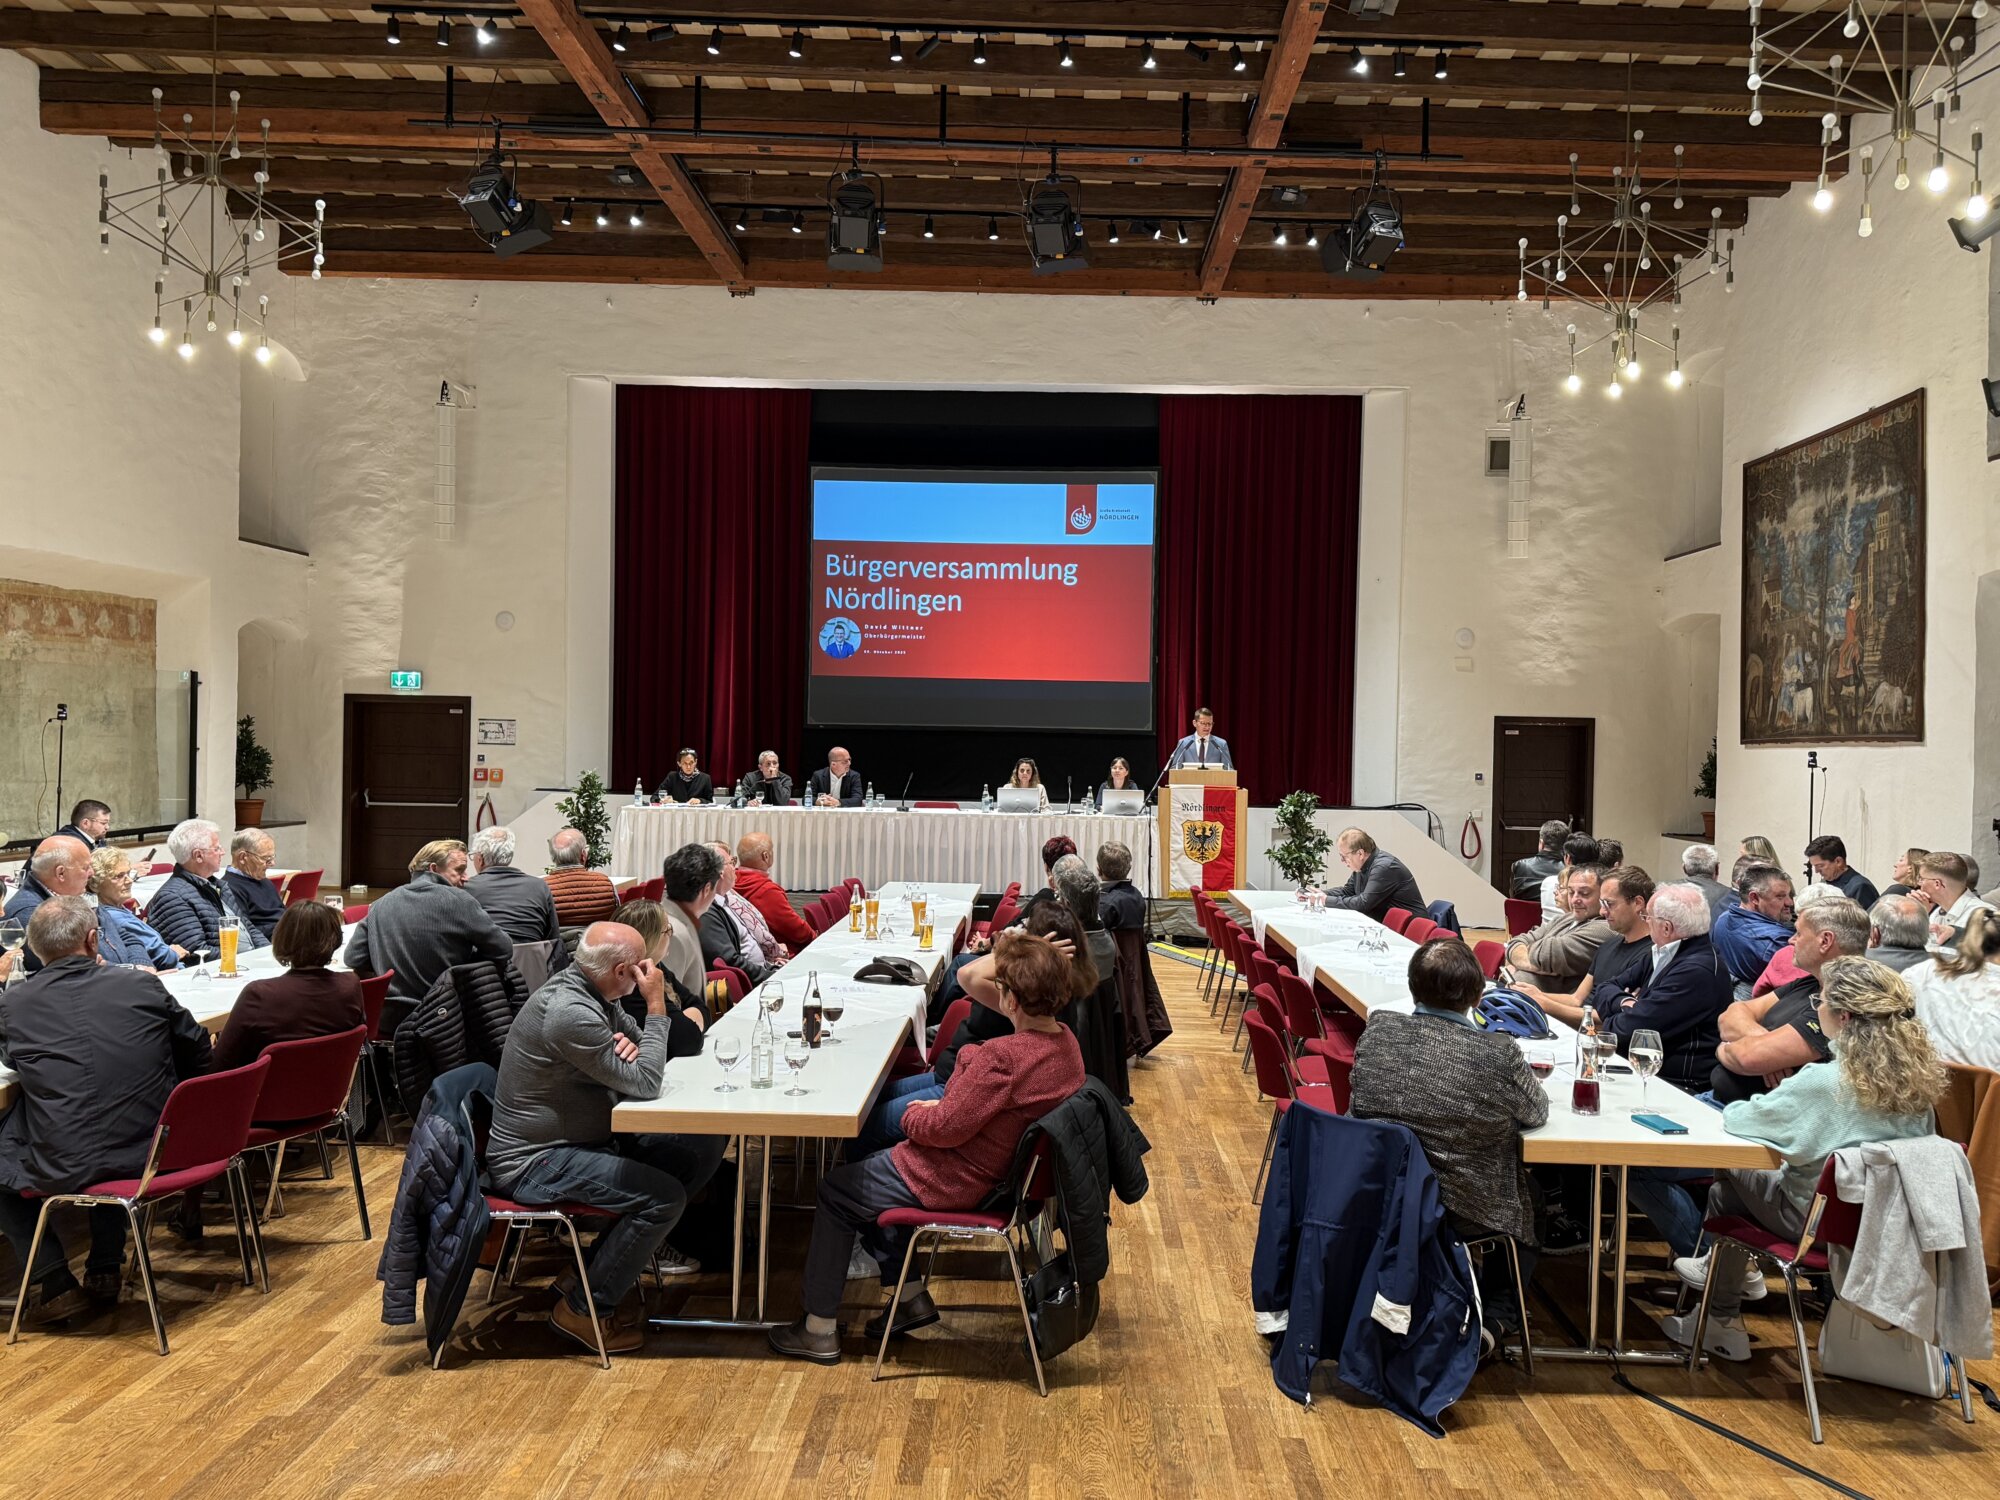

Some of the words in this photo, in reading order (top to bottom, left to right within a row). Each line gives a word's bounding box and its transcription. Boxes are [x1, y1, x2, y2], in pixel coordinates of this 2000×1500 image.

[825, 553, 1078, 586] Bürgerversammlung
[825, 586, 962, 616] Nördlingen
[1181, 802, 1226, 814] Nördlingen
